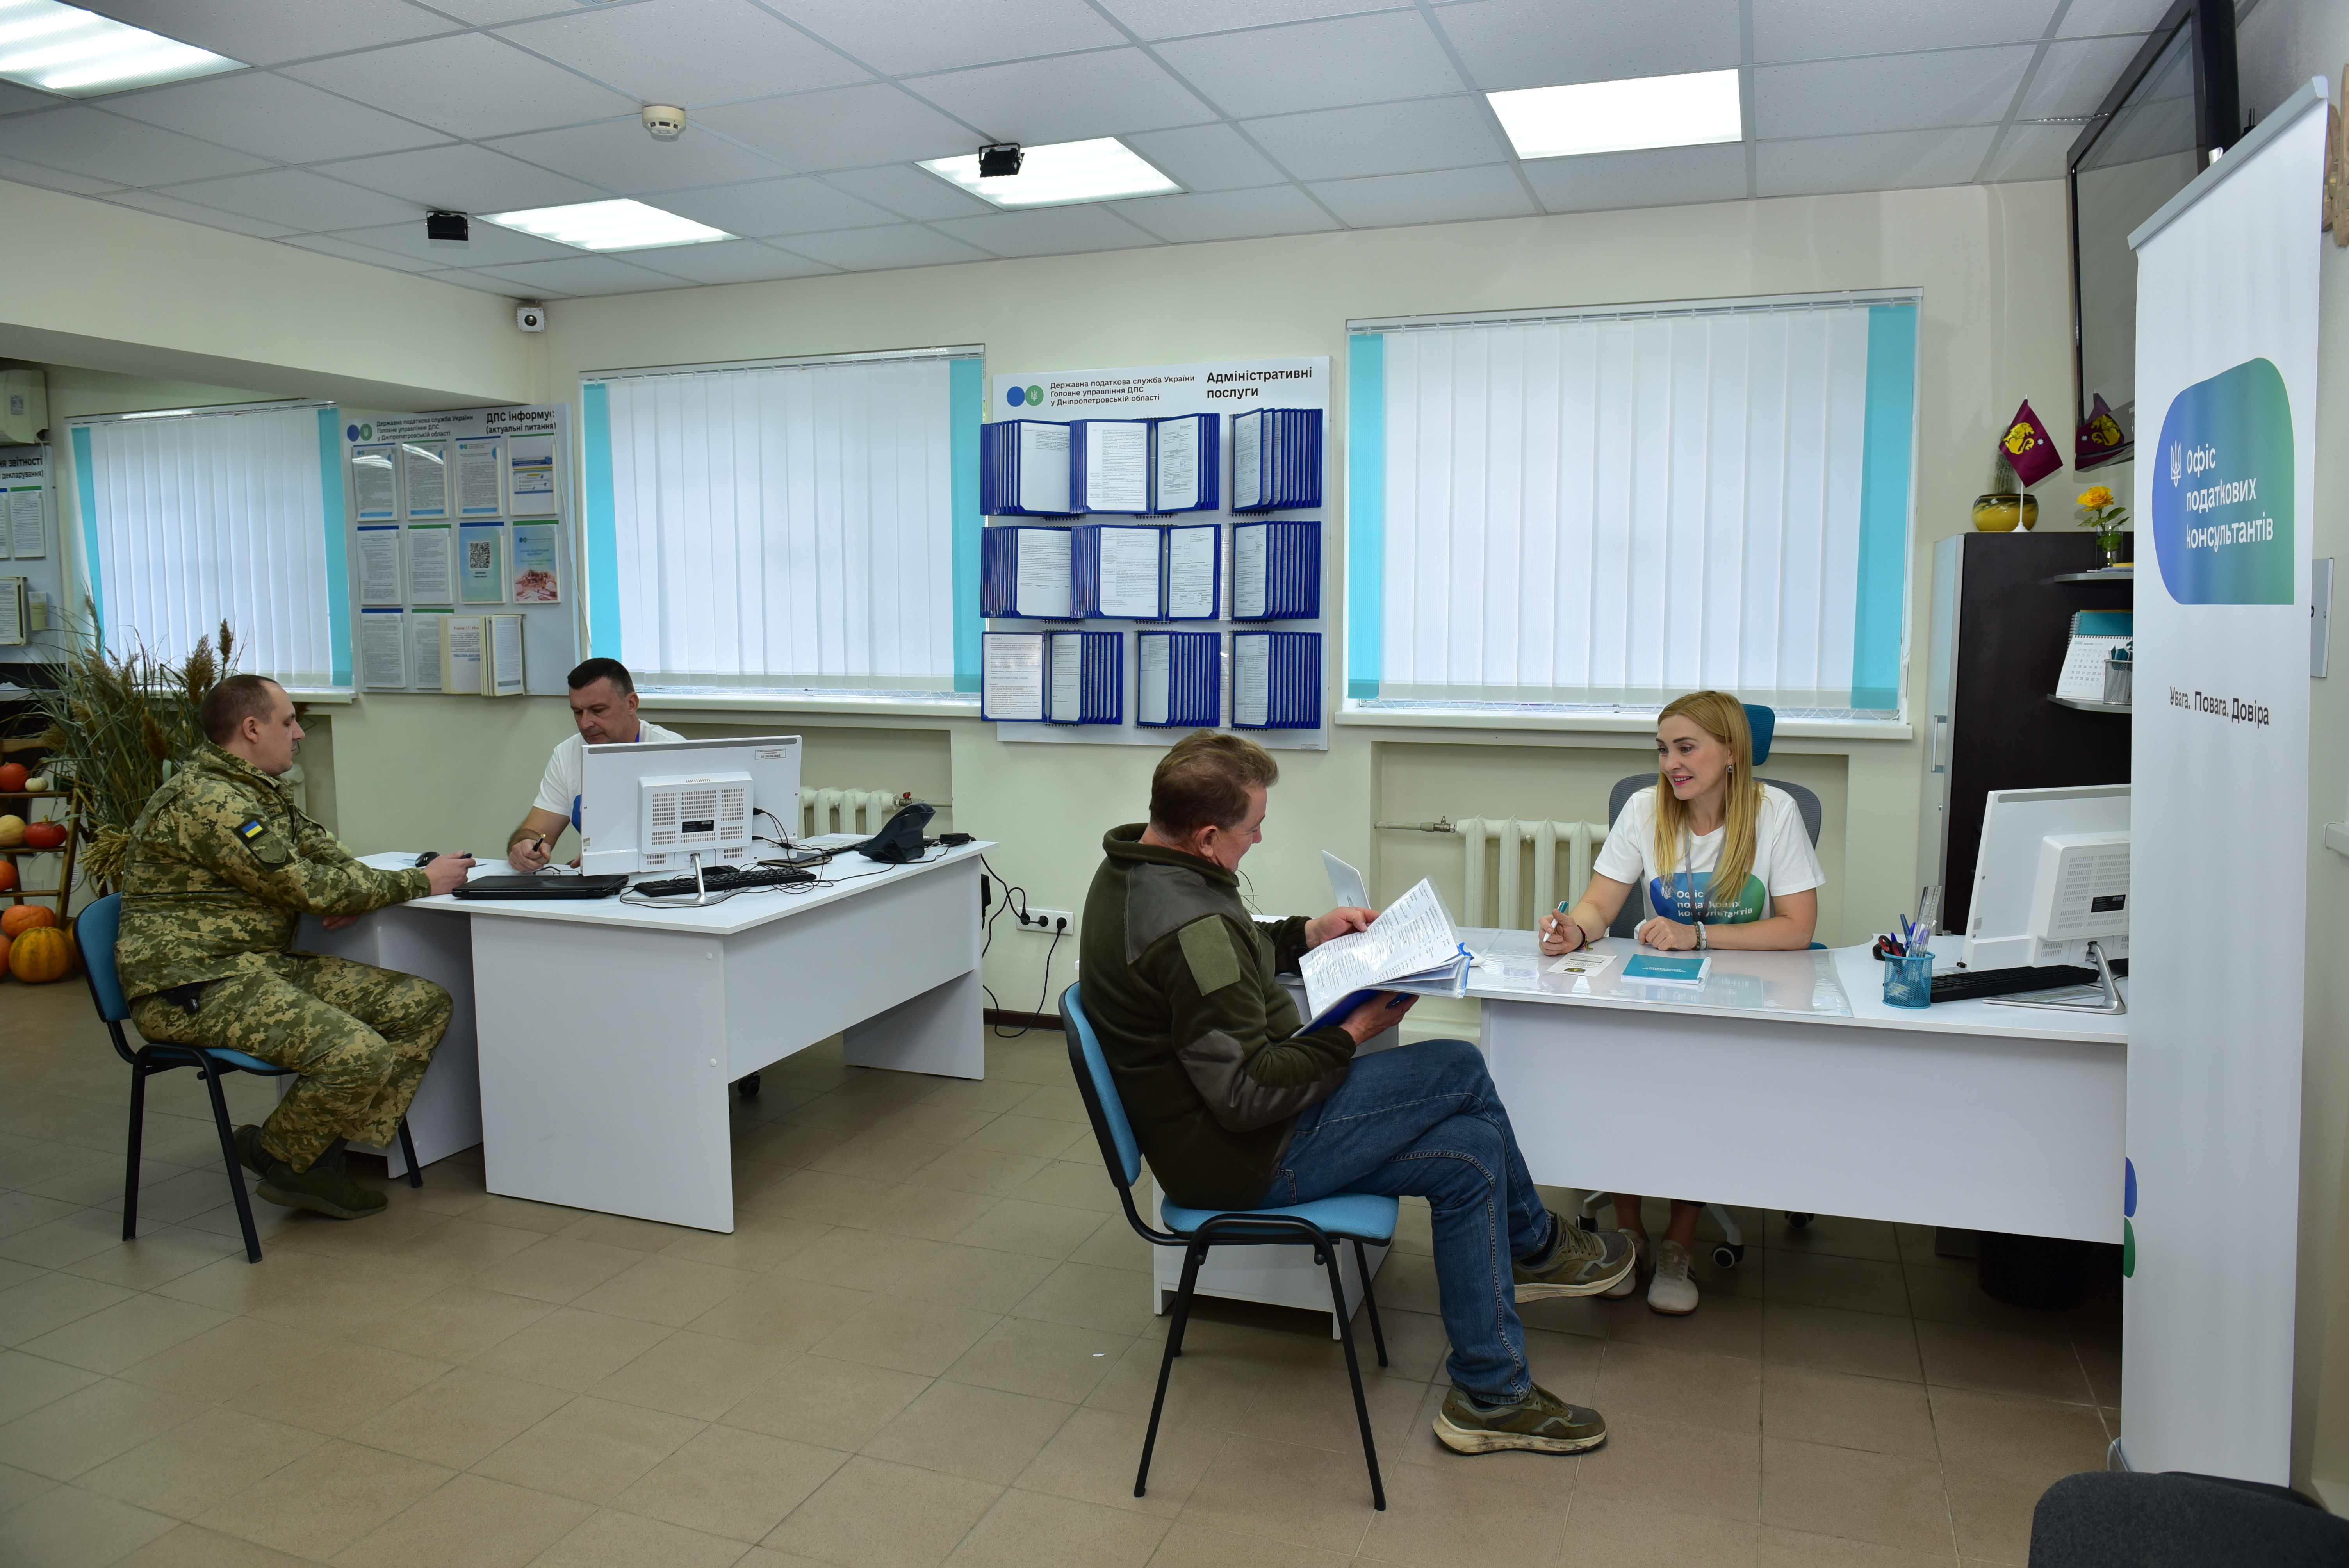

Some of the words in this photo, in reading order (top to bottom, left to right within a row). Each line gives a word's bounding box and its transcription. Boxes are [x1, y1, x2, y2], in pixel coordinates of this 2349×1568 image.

[1207, 366, 1312, 384] Адміністративні
[1050, 380, 1089, 390] Державна
[1091, 378, 1131, 388] податкова
[1133, 376, 1162, 386] служба
[1164, 374, 1195, 384] України
[1082, 387, 1125, 397] управління
[1127, 386, 1144, 394] ДПС
[1207, 388, 1258, 400] послуги
[1057, 396, 1130, 406] Дніпропетровській
[1131, 394, 1160, 402] області
[487, 412, 506, 424] ДПС
[398, 424, 427, 433] управління
[486, 424, 523, 435] (актуальні
[524, 421, 556, 431] питання)
[381, 431, 430, 441] Дніпропетровській
[8, 455, 43, 467] звітності
[2187, 443, 2216, 478] Офіс
[2, 469, 44, 480] декларування)
[2187, 478, 2257, 514] податкових
[2186, 511, 2274, 553] консультантів
[2169, 686, 2191, 710] Увага.
[2194, 691, 2229, 718] Повага.
[2231, 697, 2269, 729] Довіра
[1678, 908, 1753, 918] косультантів
